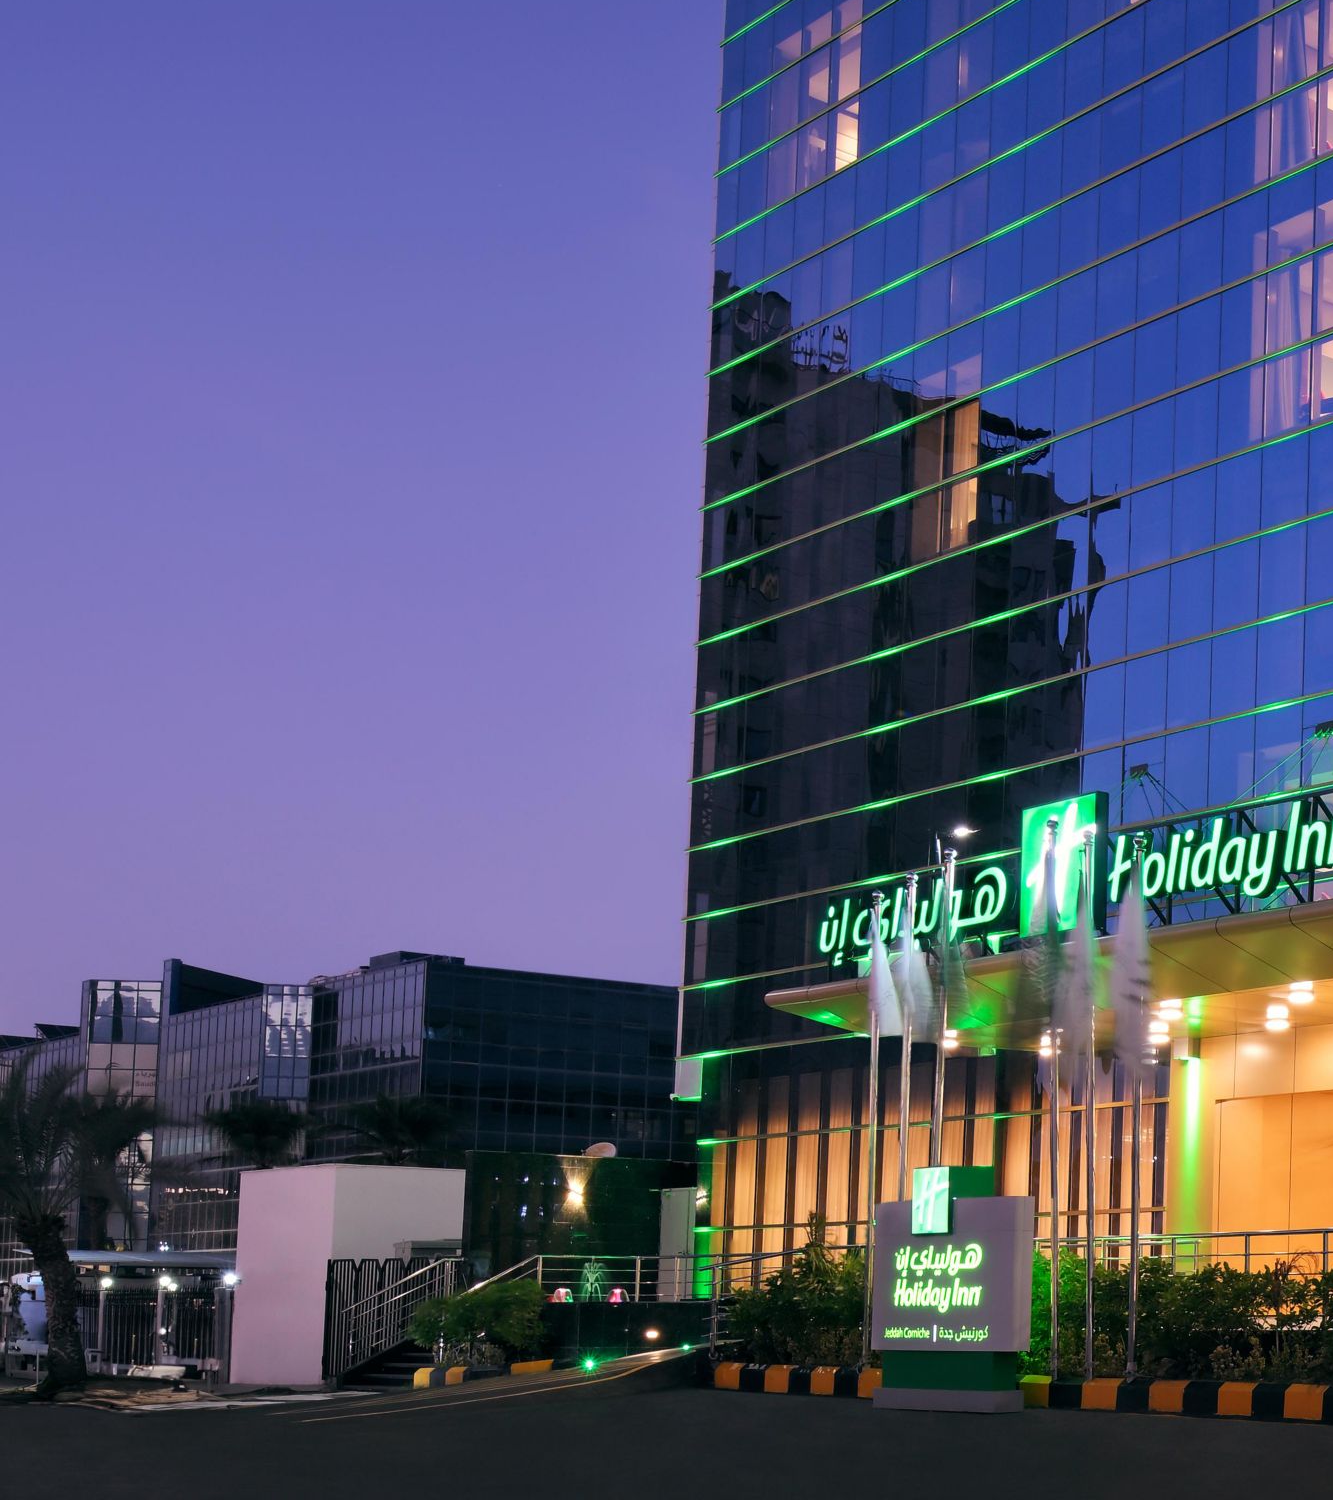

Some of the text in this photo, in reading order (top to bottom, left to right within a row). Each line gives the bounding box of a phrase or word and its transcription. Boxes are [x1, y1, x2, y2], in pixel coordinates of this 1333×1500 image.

[1109, 817, 1279, 902] Holiday
[820, 898, 851, 967] إن
[896, 1243, 983, 1277] هوليداي إن
[893, 1277, 981, 1314] Holiday Inn
[884, 1327, 903, 1339] Jeddah
[938, 1325, 989, 1342] كورنيش جدة
